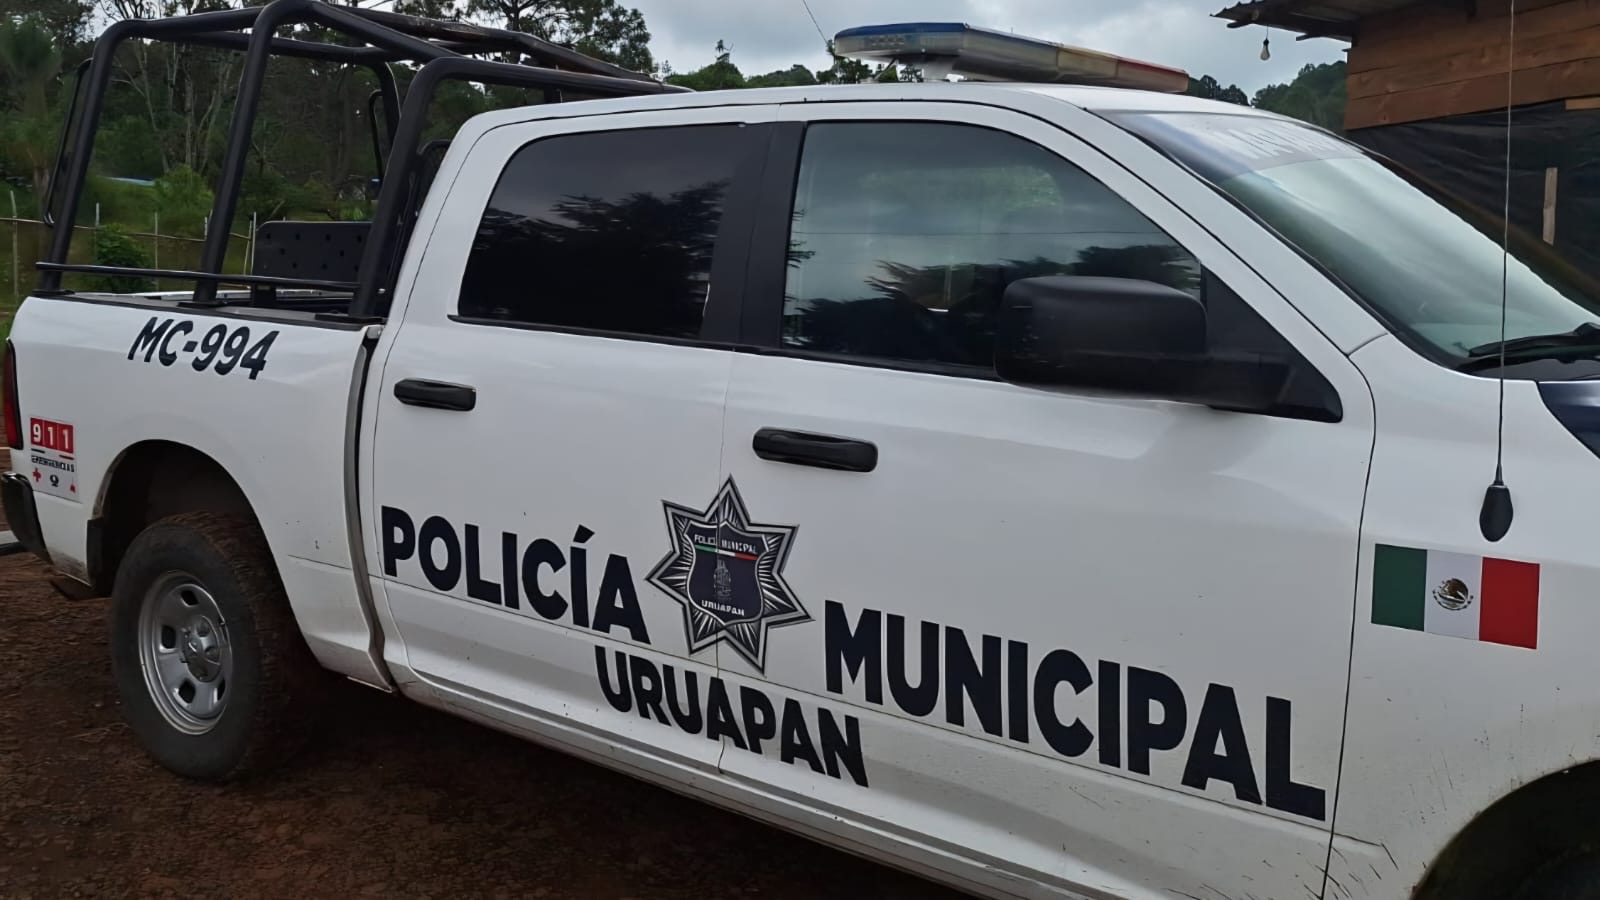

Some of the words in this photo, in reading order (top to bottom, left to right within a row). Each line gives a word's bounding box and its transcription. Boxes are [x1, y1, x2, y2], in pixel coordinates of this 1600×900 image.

[128, 316, 280, 380] MC-994
[32, 423, 70, 450] 911
[701, 599, 745, 616] URUAPAN
[381, 505, 652, 645] POLICÍA
[824, 599, 1326, 822] MUNICIPAL
[594, 644, 869, 788] URUAPAN
